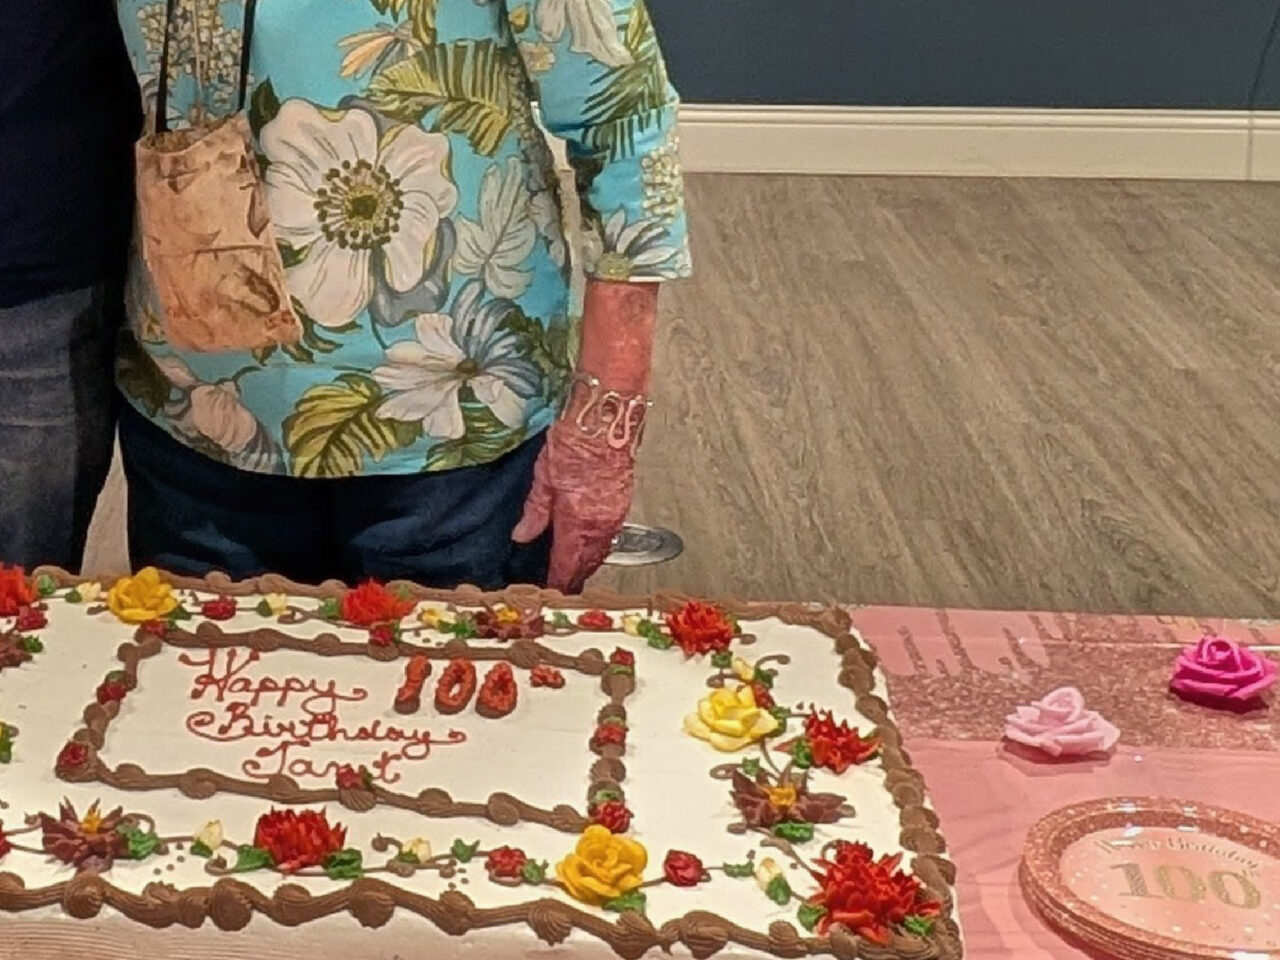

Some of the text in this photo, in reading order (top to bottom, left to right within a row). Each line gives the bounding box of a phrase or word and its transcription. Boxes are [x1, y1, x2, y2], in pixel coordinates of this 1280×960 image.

[178, 645, 518, 720] Happy 100
[186, 701, 468, 760] Birthday
[241, 739, 404, 784] Jant
[1109, 862, 1263, 911] 100
